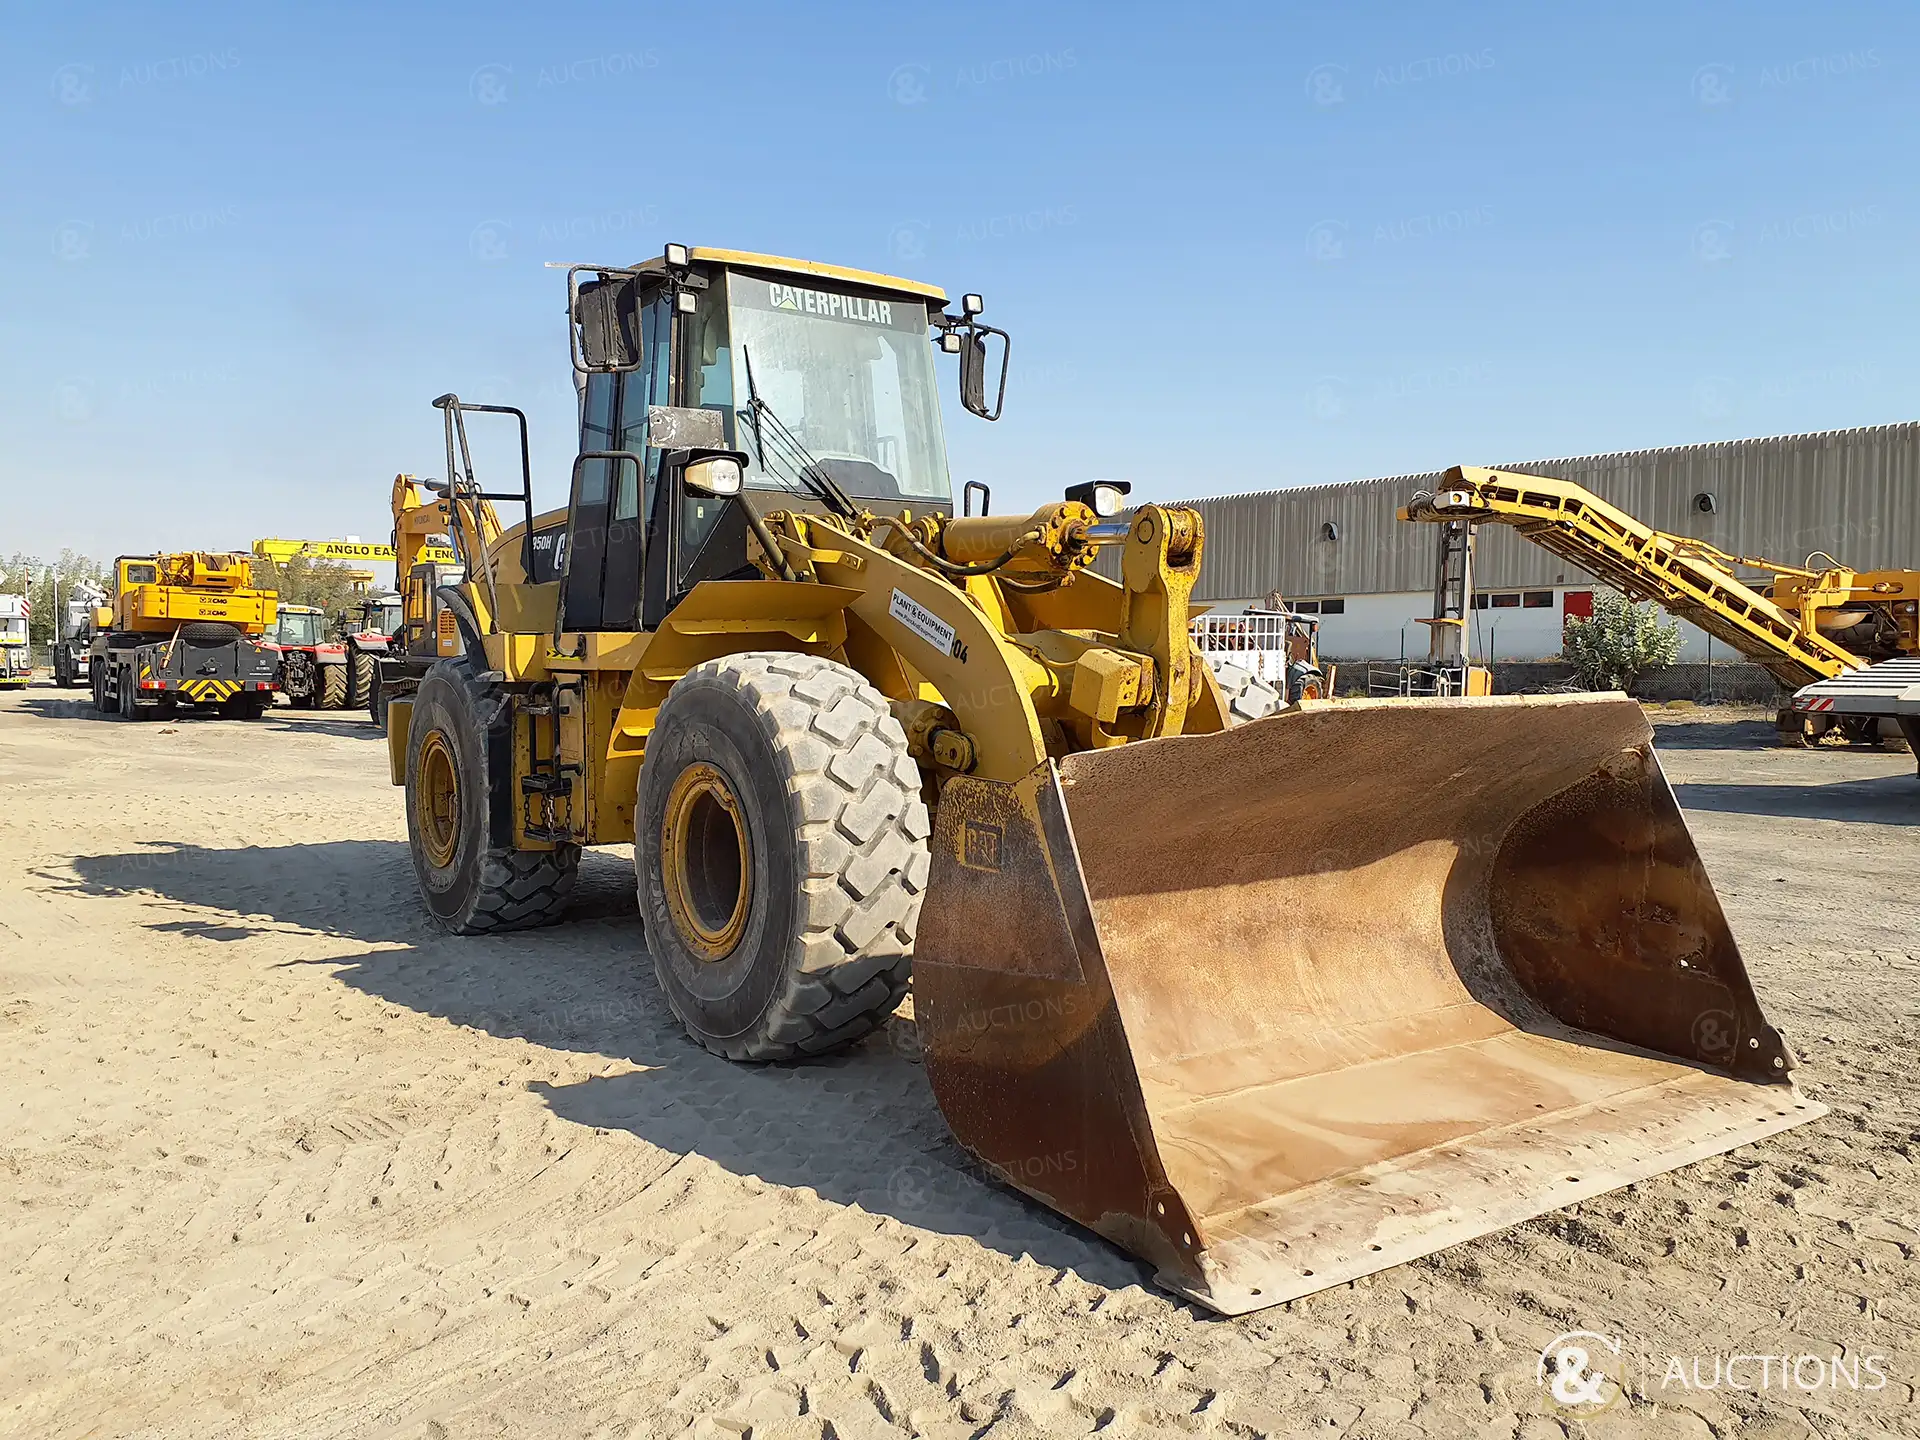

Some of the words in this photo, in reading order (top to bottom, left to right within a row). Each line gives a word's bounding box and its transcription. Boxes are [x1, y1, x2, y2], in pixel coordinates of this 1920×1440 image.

[768, 283, 892, 325] CATERPILLAR
[326, 545, 370, 556] ANGLO
[532, 535, 553, 550] 950H
[892, 593, 912, 612] PLANT
[917, 611, 952, 641] EQUIPMENT
[951, 639, 968, 664] 04
